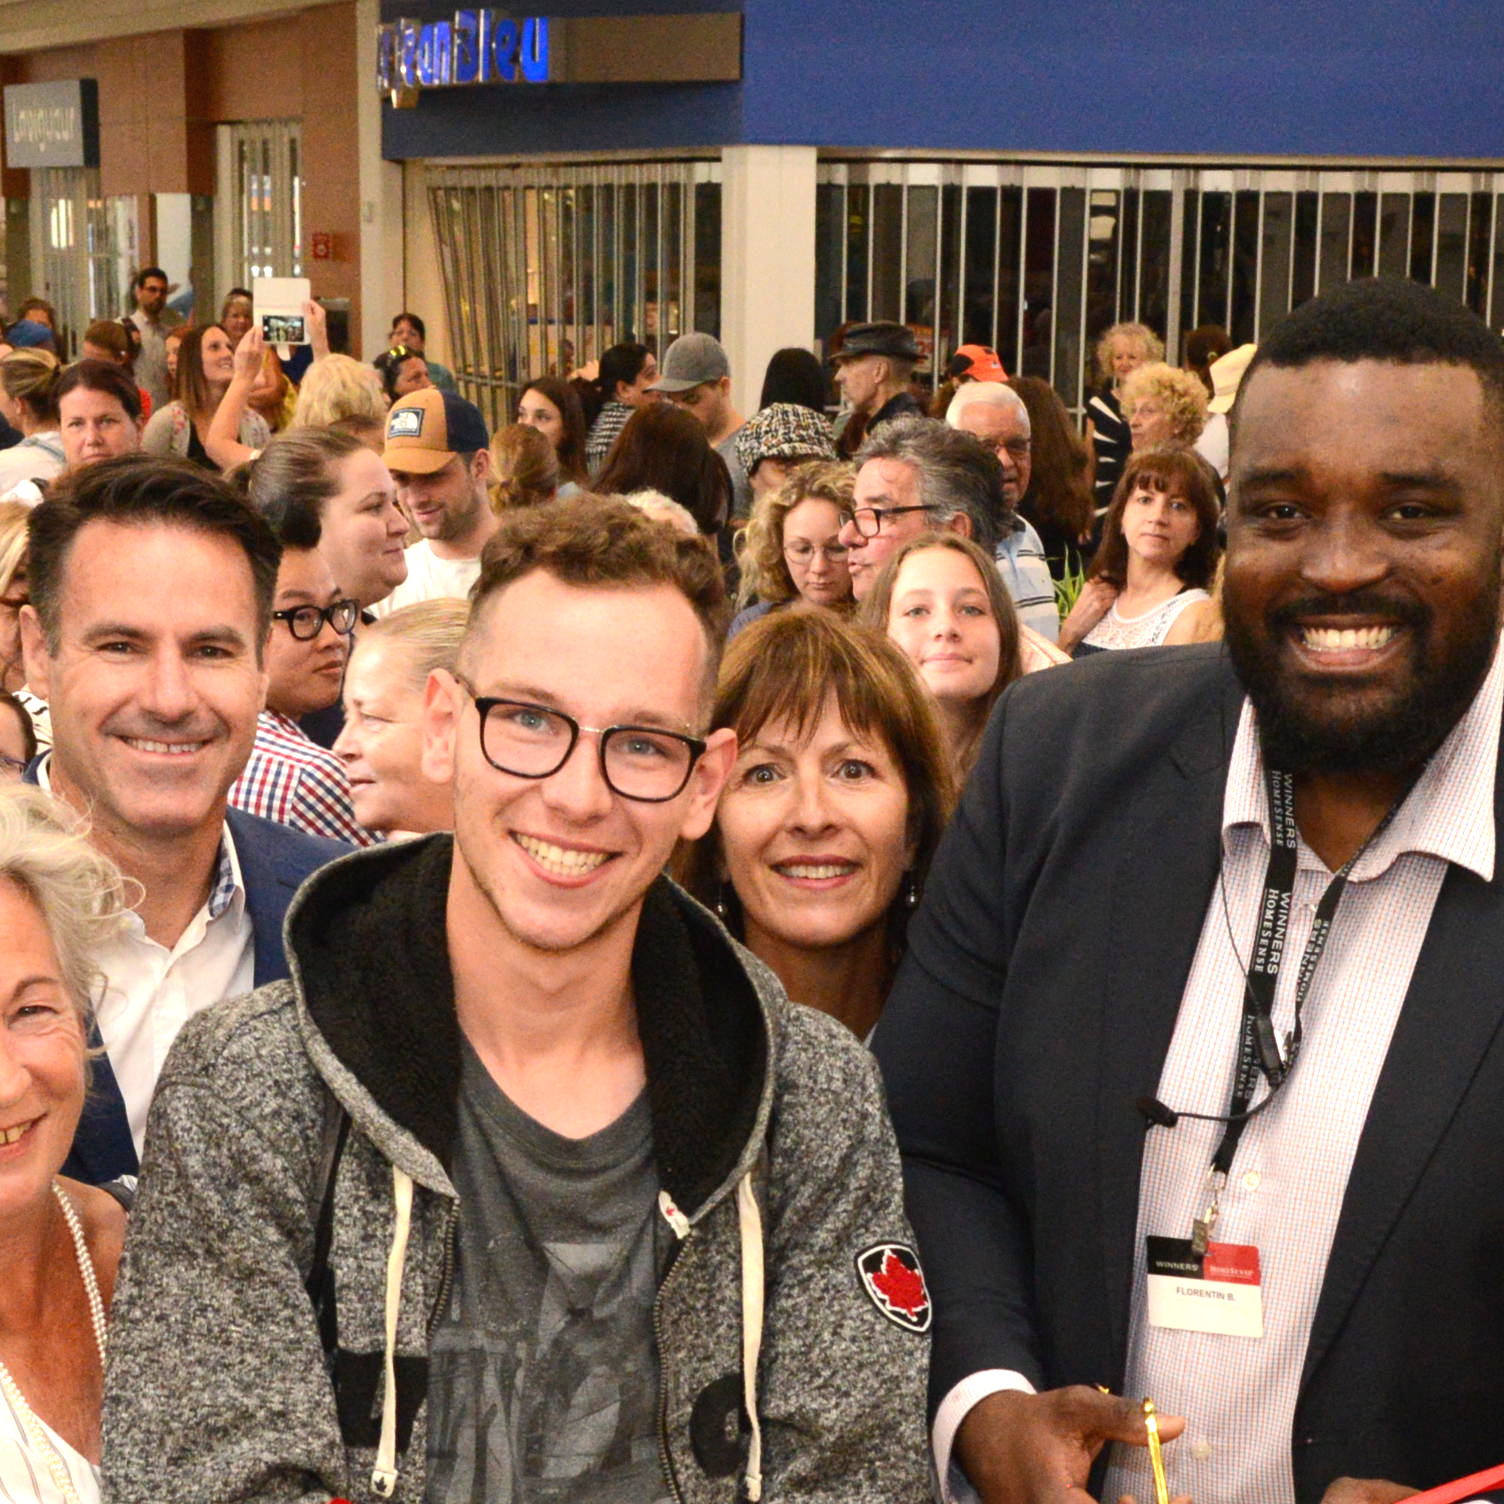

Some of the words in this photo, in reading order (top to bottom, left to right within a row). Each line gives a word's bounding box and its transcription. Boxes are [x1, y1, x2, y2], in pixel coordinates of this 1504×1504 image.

[1270, 769, 1285, 848] HOMESENSE
[1283, 772, 1297, 850] WINNERS
[1253, 887, 1280, 973] HOMESENSE
[1265, 891, 1292, 976] WINNERS
[1155, 1260, 1200, 1272] WINNERS
[1176, 1286, 1225, 1300] FLORENTIN
